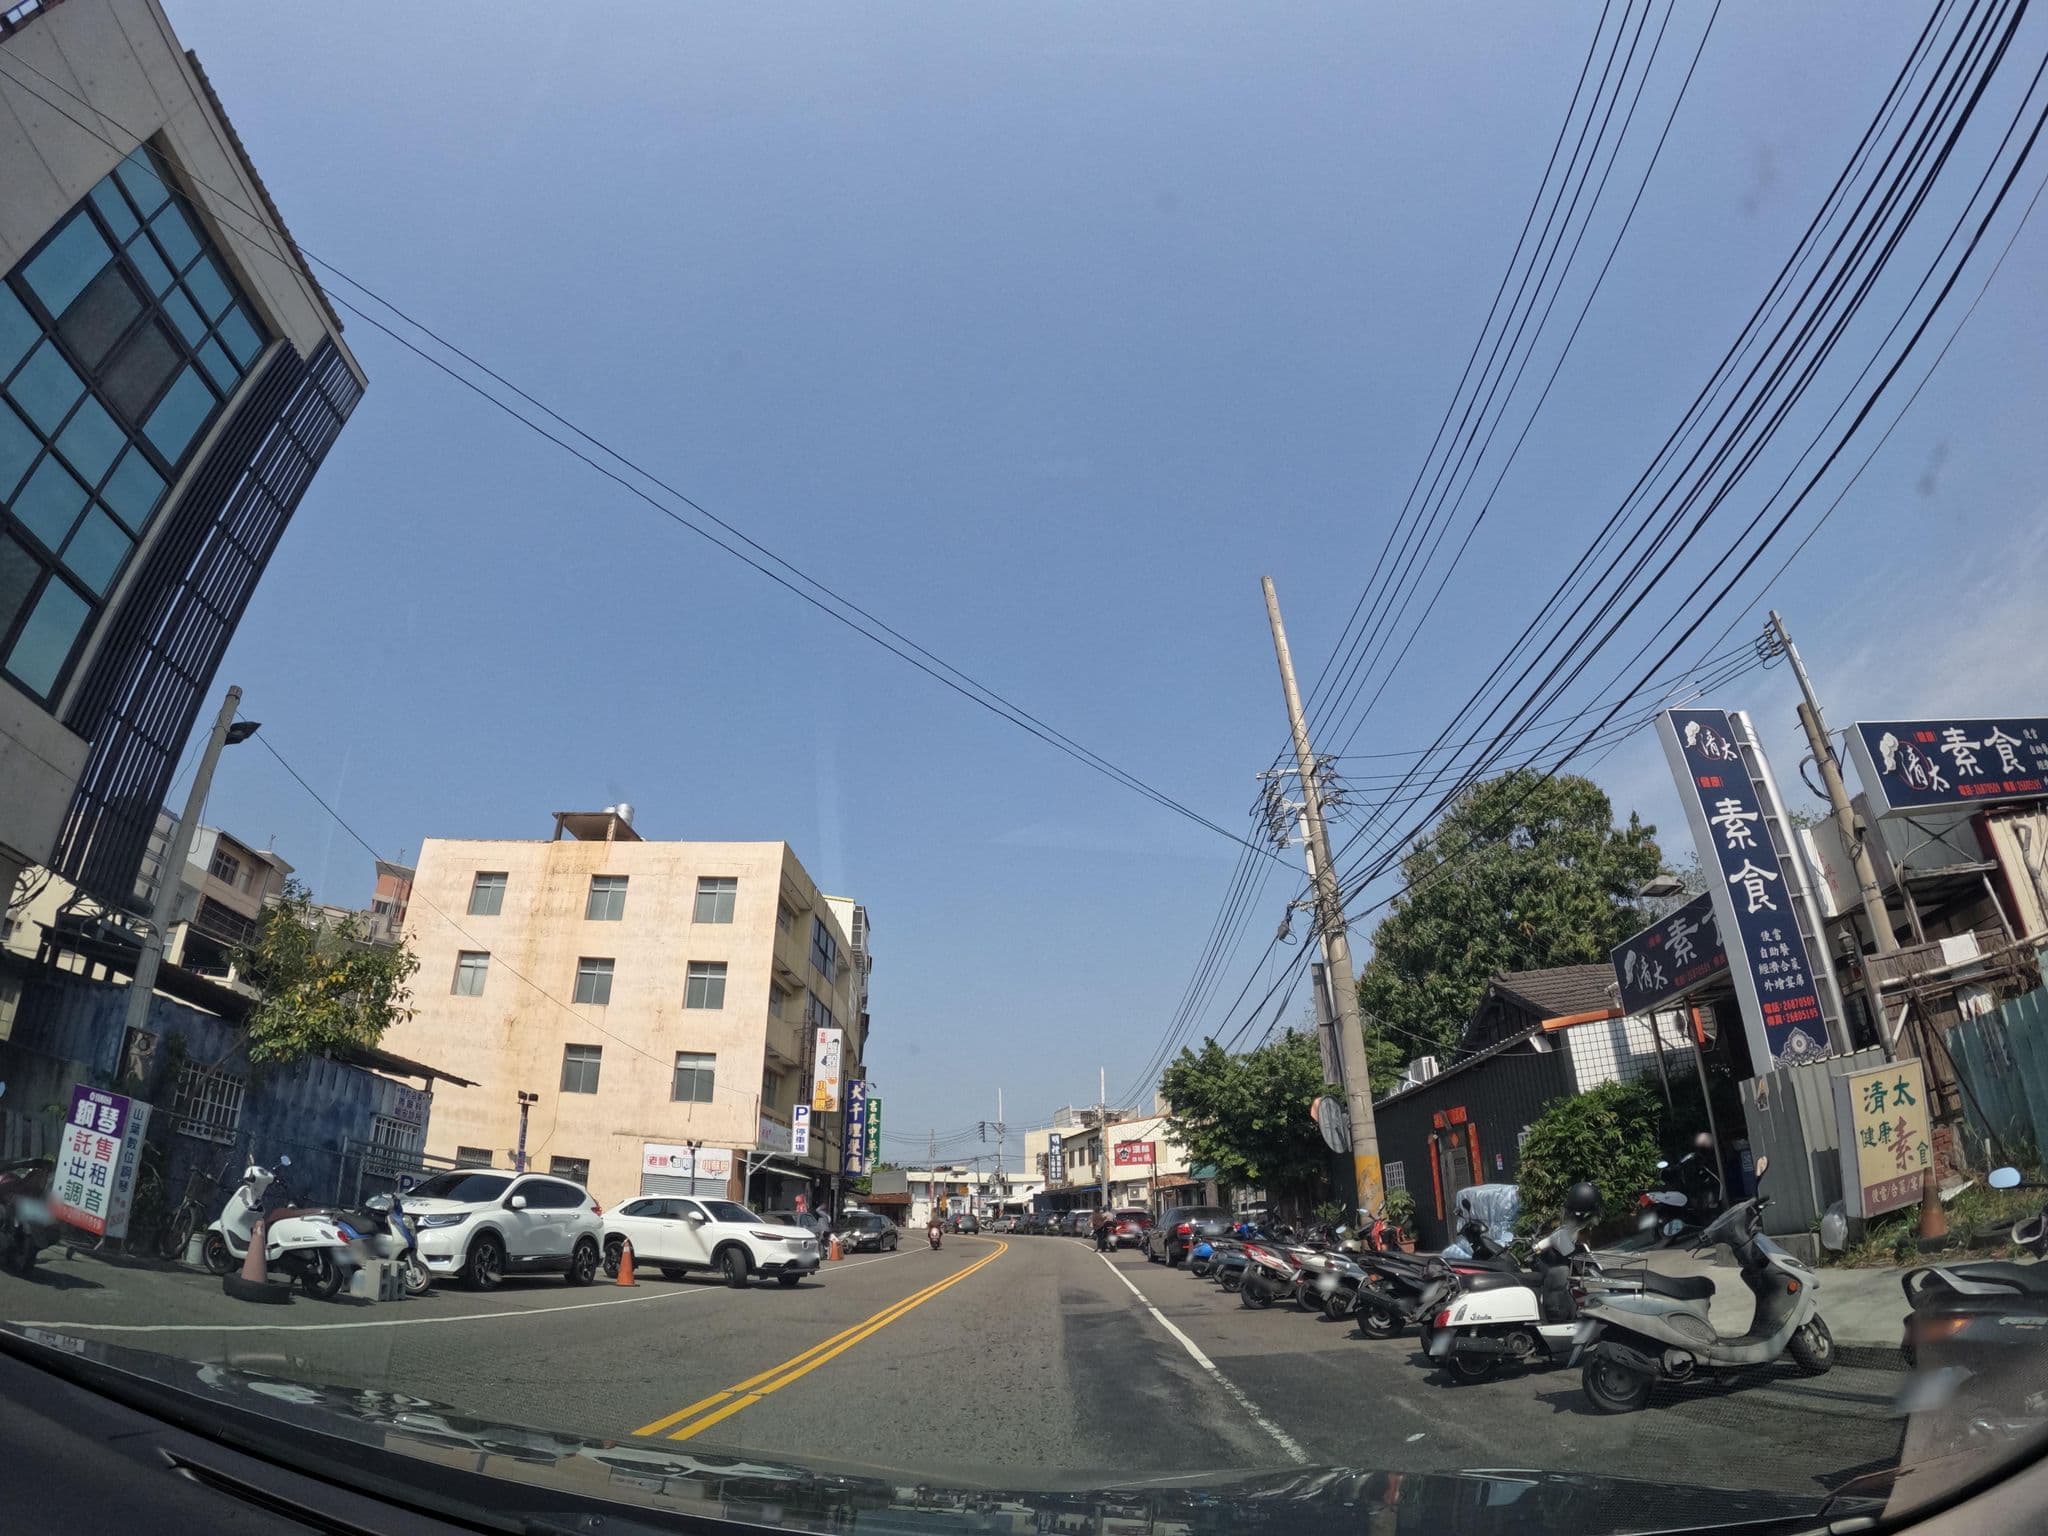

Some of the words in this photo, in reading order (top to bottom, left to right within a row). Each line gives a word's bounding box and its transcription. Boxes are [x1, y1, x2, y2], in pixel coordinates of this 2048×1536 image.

[1940, 725, 2026, 777] 素食
[1711, 797, 1779, 914] 素食
[1863, 1075, 1916, 1115] 清太
[74, 1099, 120, 1135] 鋼琴
[795, 1107, 808, 1121] P
[73, 1130, 114, 1163] 託售
[795, 1128, 806, 1152] 停車場
[69, 1155, 107, 1188] 出租
[64, 1179, 103, 1214] 調音
